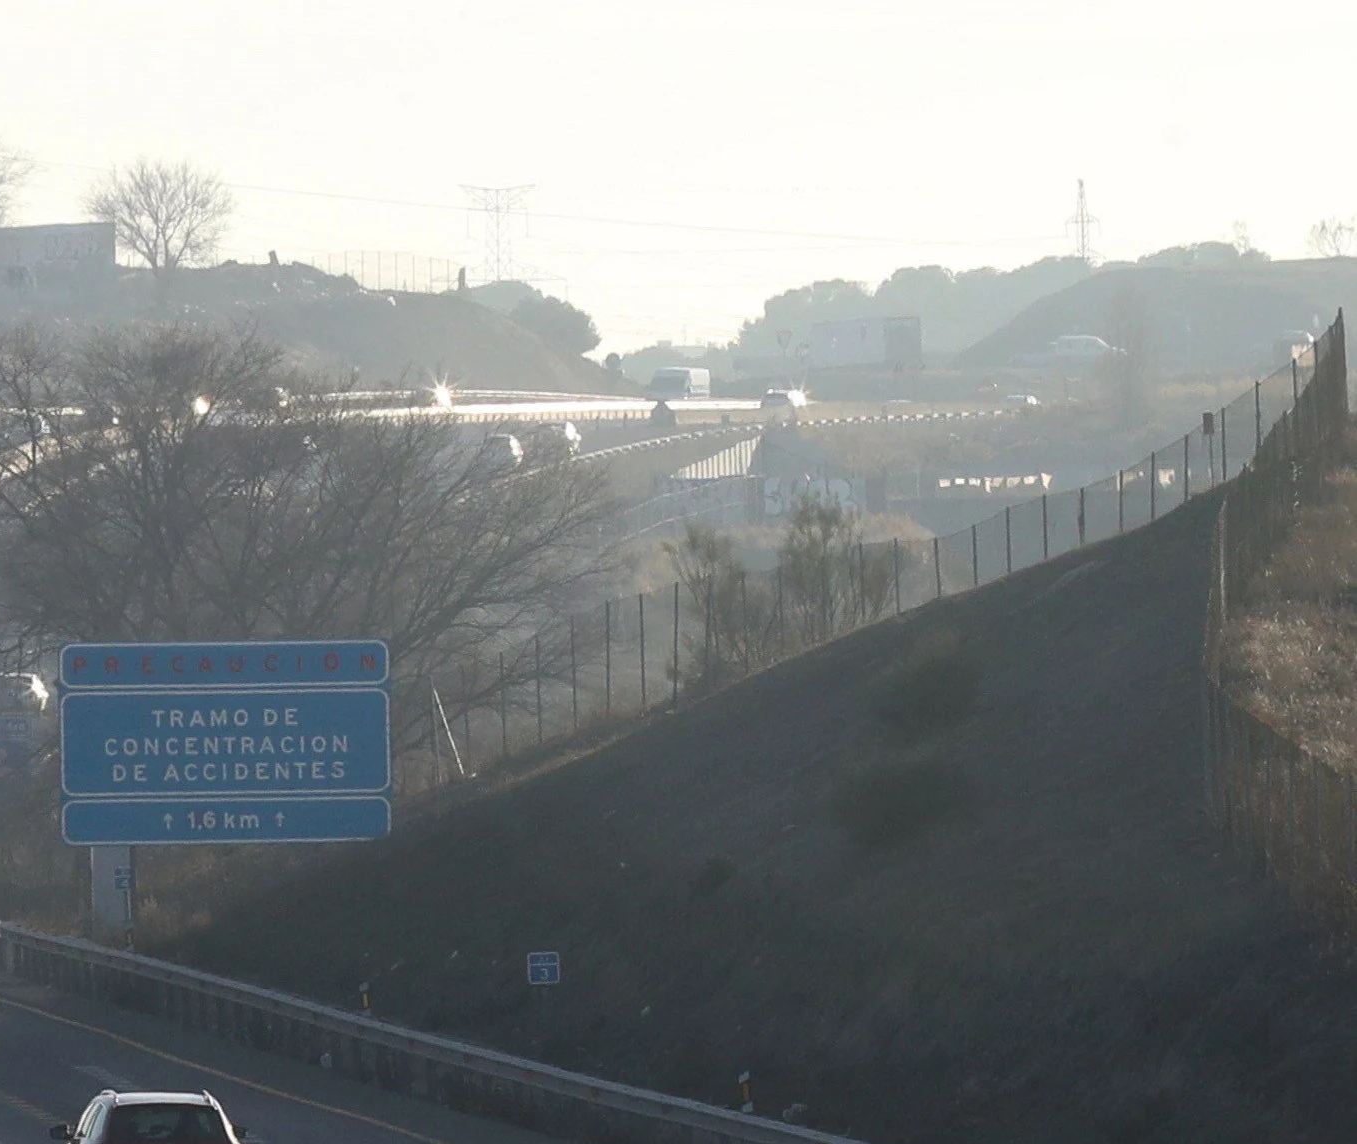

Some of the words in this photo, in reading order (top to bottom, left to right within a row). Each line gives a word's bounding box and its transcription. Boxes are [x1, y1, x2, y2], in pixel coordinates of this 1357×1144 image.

[151, 708, 250, 729] TRAMO
[263, 708, 299, 727] DE
[105, 735, 350, 757] CONCENTRACION
[112, 763, 148, 783] DE
[164, 761, 346, 783] ACCIDENTES
[223, 810, 260, 829] km
